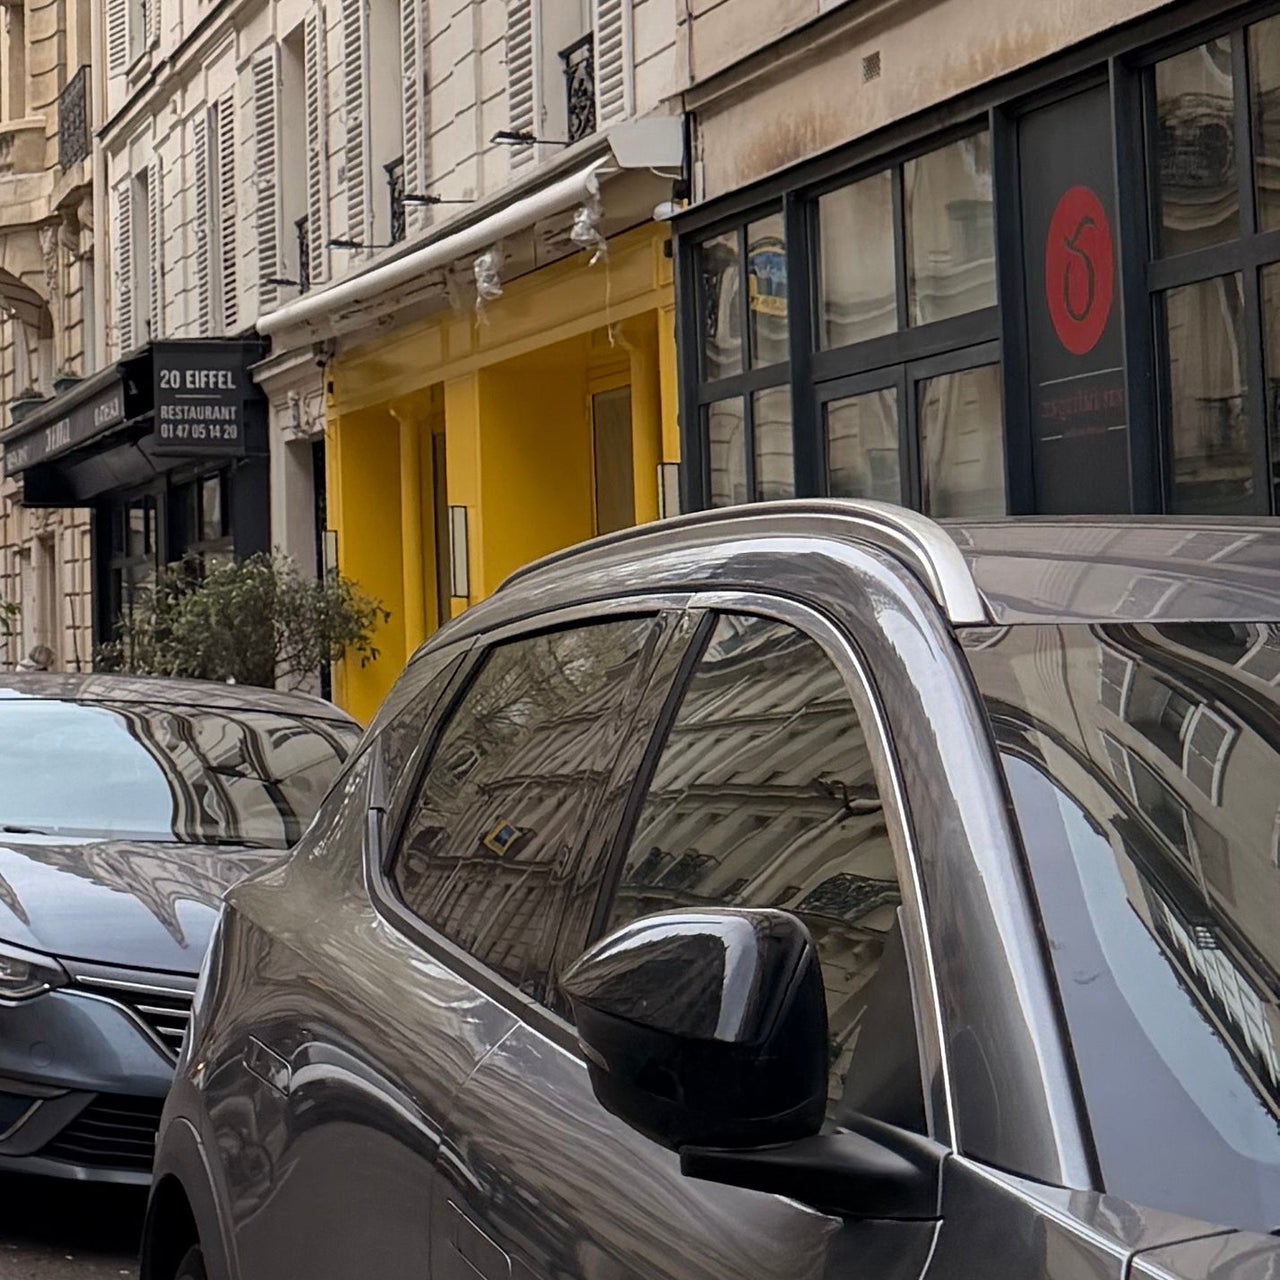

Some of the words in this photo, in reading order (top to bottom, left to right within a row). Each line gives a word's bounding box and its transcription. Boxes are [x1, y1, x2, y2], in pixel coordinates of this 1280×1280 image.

[160, 369, 180, 389] 20
[185, 369, 236, 389] EIFFEL
[160, 405, 236, 420] RESTAURANT
[160, 423, 173, 438] 01
[176, 424, 189, 438] 47
[191, 424, 206, 439] 05
[208, 424, 221, 439] 14
